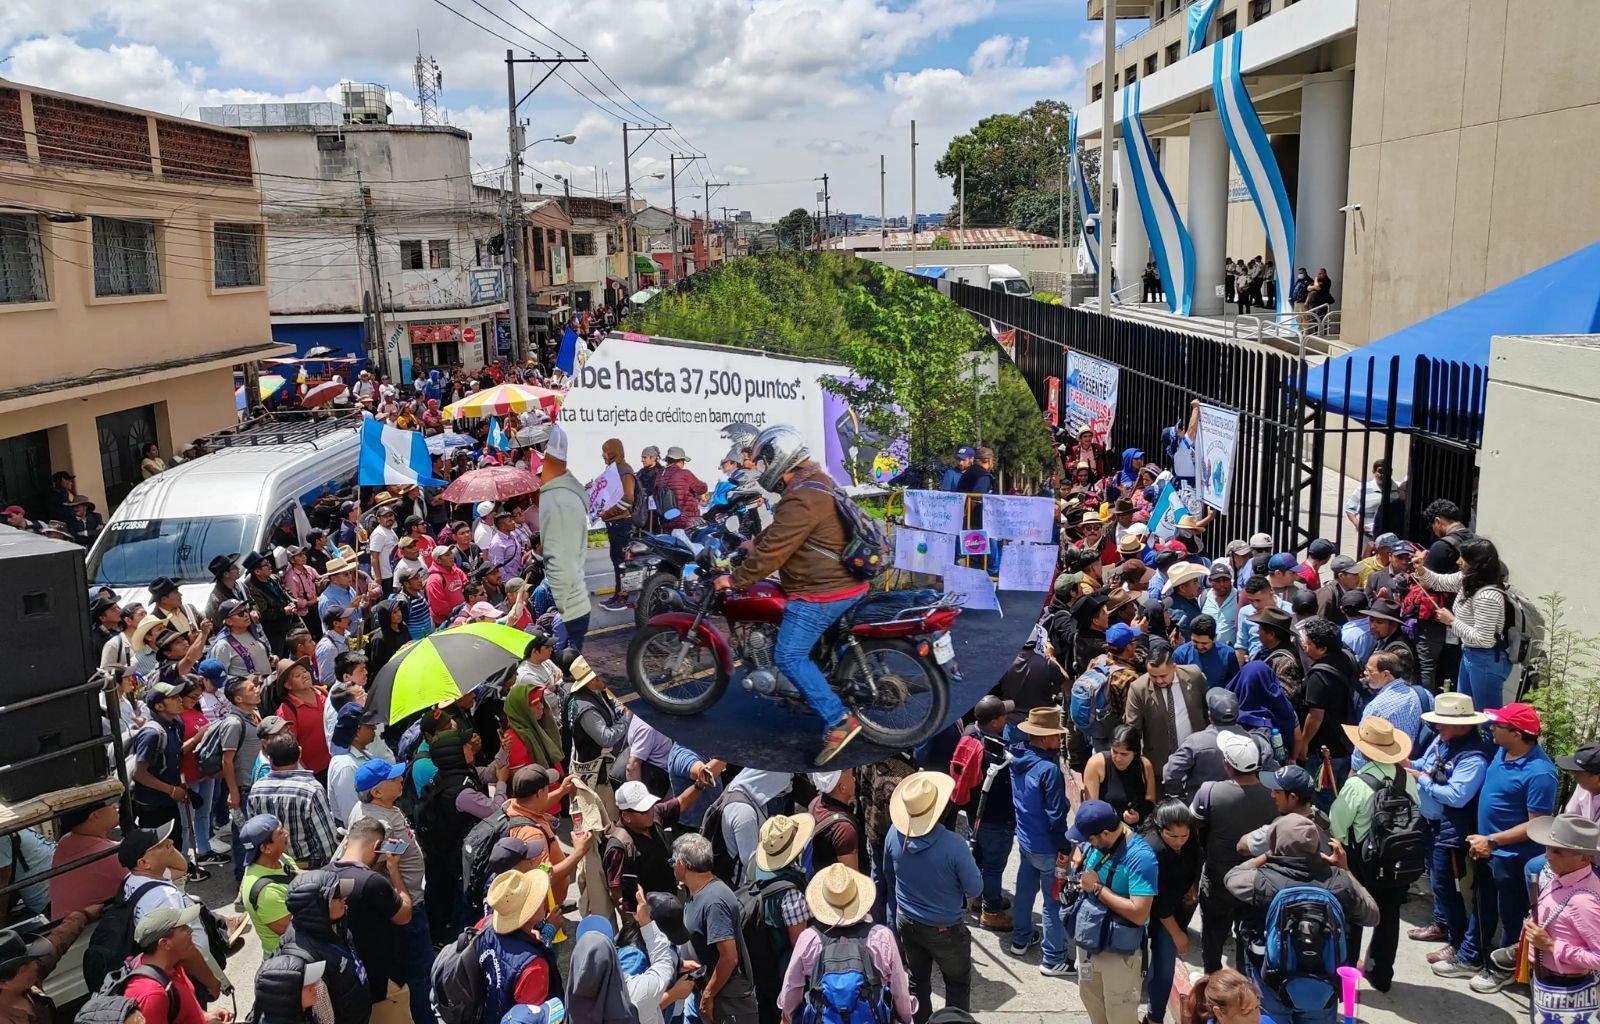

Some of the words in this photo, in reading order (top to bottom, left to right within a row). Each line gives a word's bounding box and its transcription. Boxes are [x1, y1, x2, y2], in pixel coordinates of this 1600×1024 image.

[615, 360, 676, 393] hasta
[679, 367, 742, 399] 37,500
[579, 407, 594, 422] tu
[597, 405, 637, 427] tarjeta
[640, 406, 653, 422] de
[655, 406, 692, 423] crédito
[694, 411, 707, 423] en
[709, 407, 767, 427] bam.com.gt
